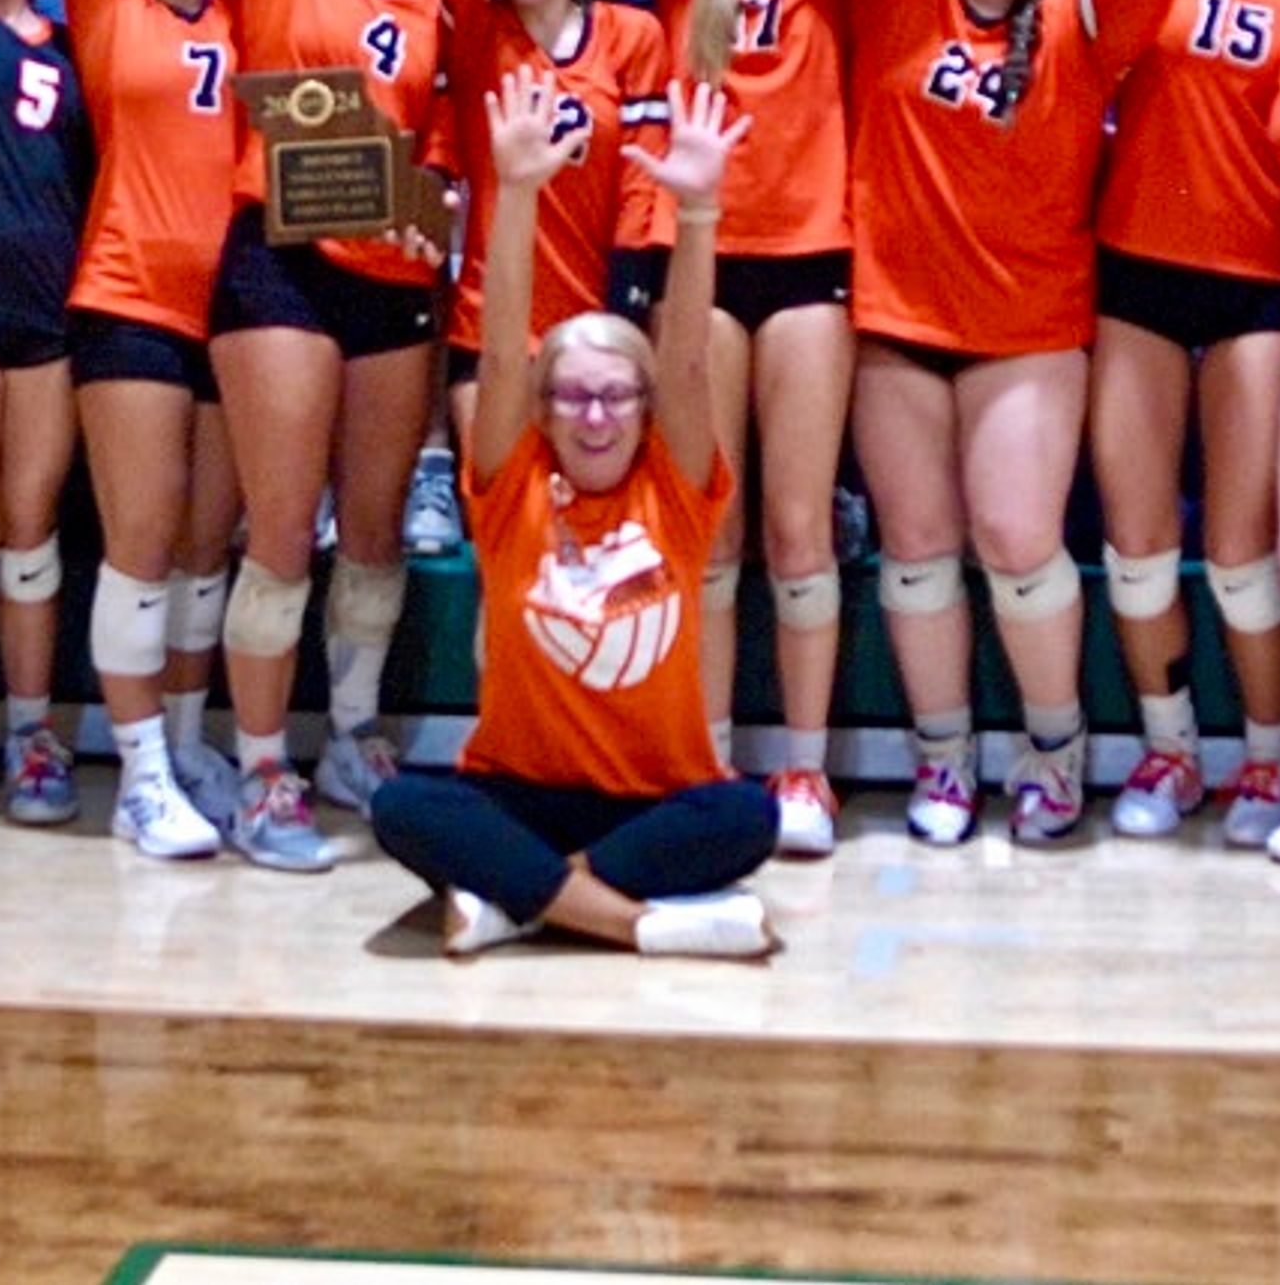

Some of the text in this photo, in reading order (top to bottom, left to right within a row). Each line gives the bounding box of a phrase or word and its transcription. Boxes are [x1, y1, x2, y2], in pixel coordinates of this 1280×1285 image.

[183, 42, 226, 112] 7
[361, 13, 406, 82] 4
[15, 58, 61, 129] 5
[334, 90, 362, 112] 24
